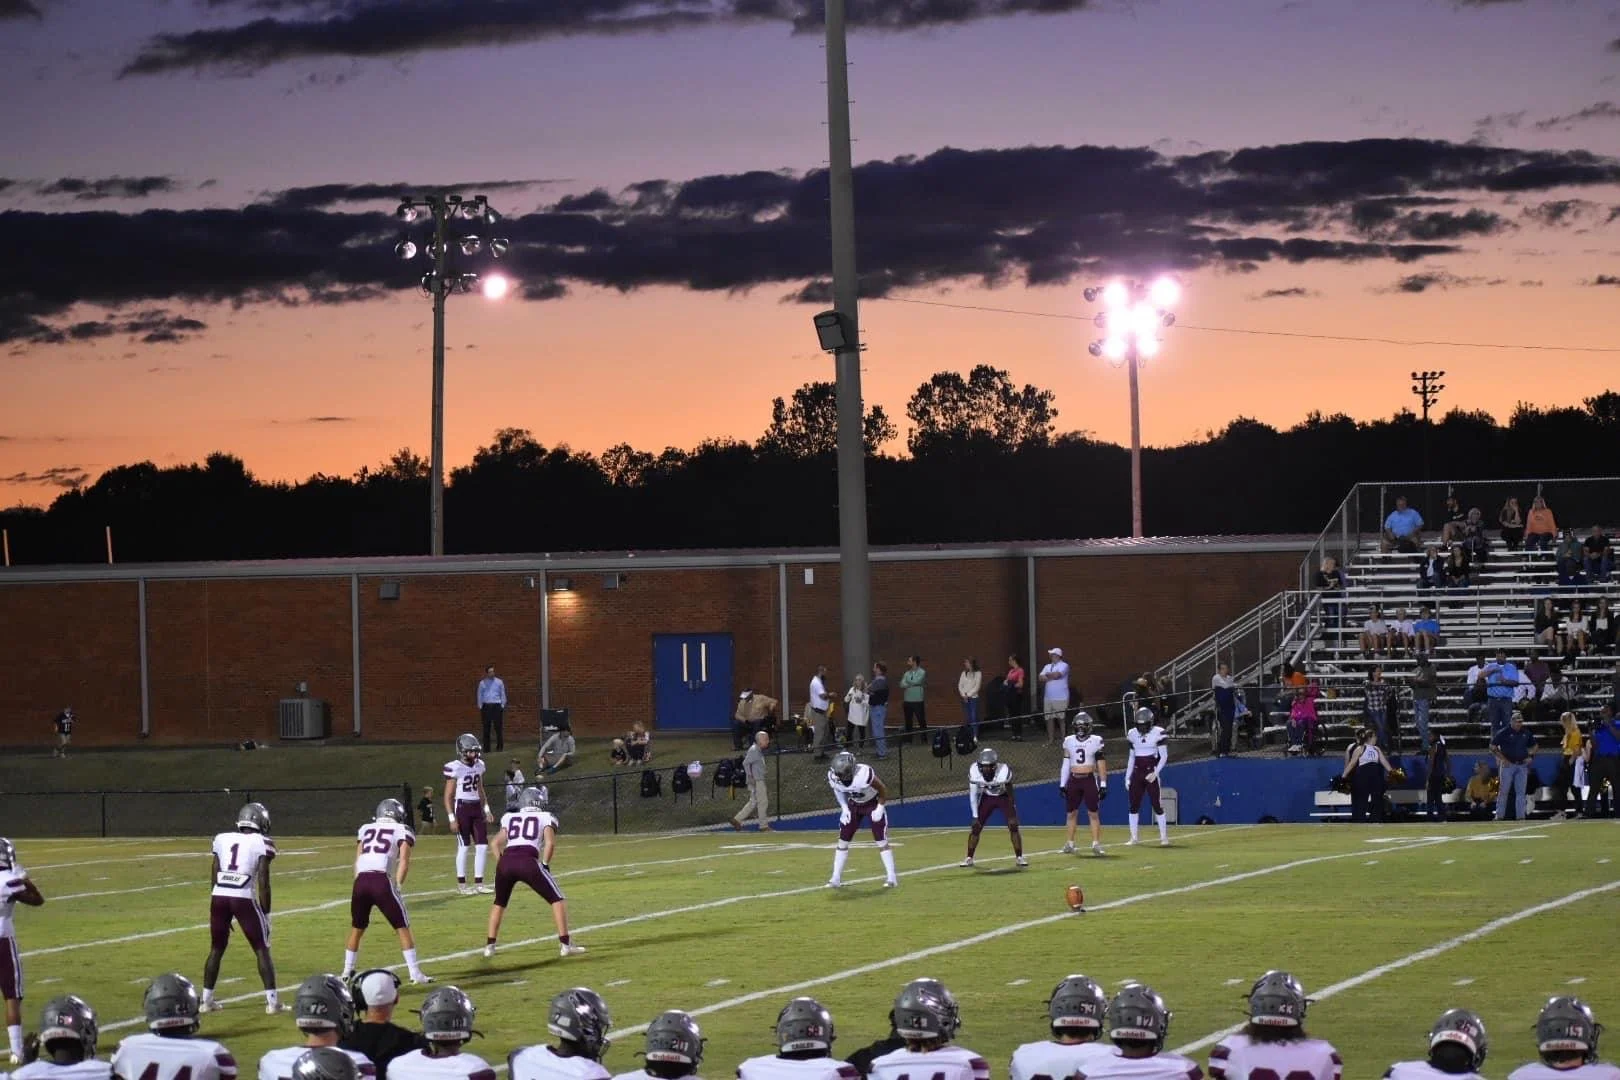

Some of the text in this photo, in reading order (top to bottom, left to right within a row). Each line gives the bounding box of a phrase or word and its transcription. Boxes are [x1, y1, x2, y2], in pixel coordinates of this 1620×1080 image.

[1075, 748, 1086, 764] 3
[361, 828, 395, 854] 25
[507, 816, 540, 841] 60
[227, 843, 241, 871] 1
